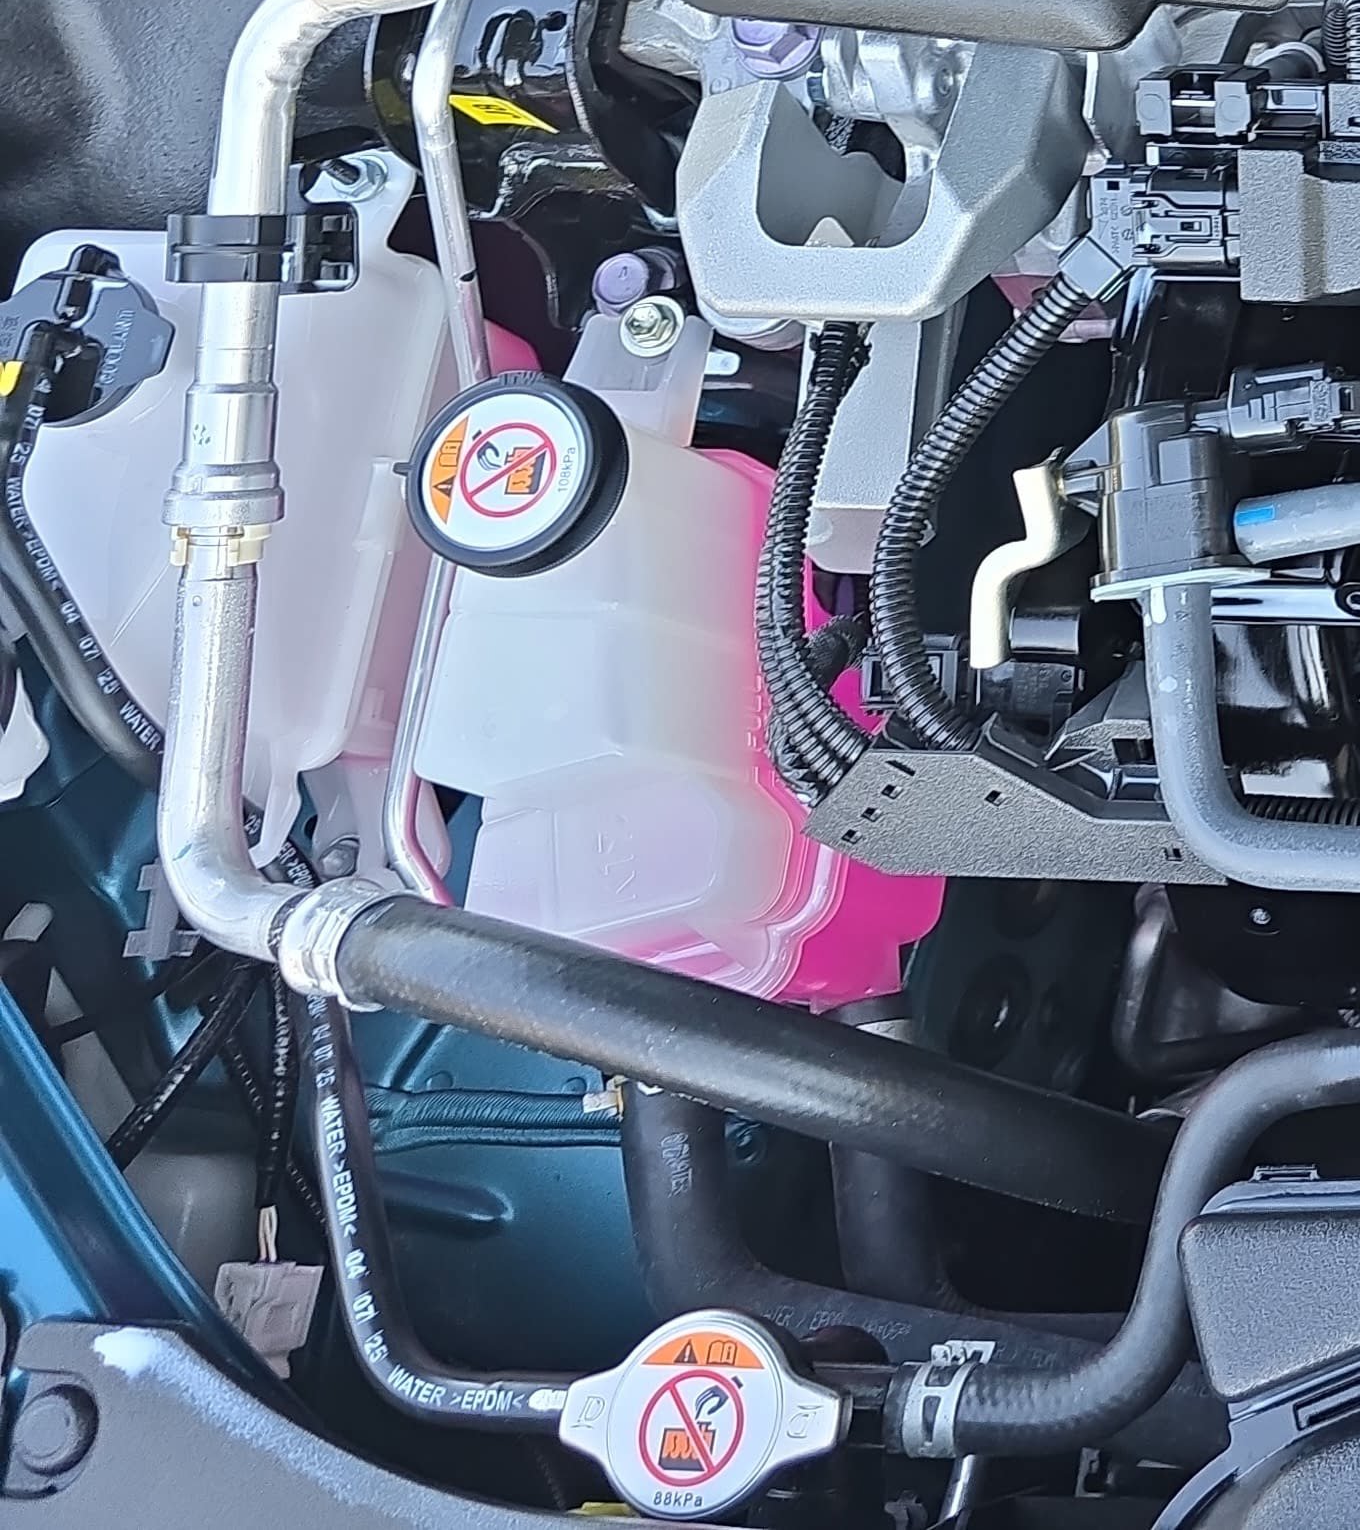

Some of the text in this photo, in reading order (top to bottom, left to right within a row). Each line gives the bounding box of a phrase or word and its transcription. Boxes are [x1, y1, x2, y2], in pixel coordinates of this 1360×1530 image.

[98, 309, 137, 385] COOLANT
[557, 446, 577, 494] 108kPa
[7, 476, 30, 528] WATER
[119, 700, 163, 752] WATER
[320, 1093, 348, 1159] WATER
[386, 1363, 446, 1407] WATER
[652, 1490, 704, 1508] 88kPa
